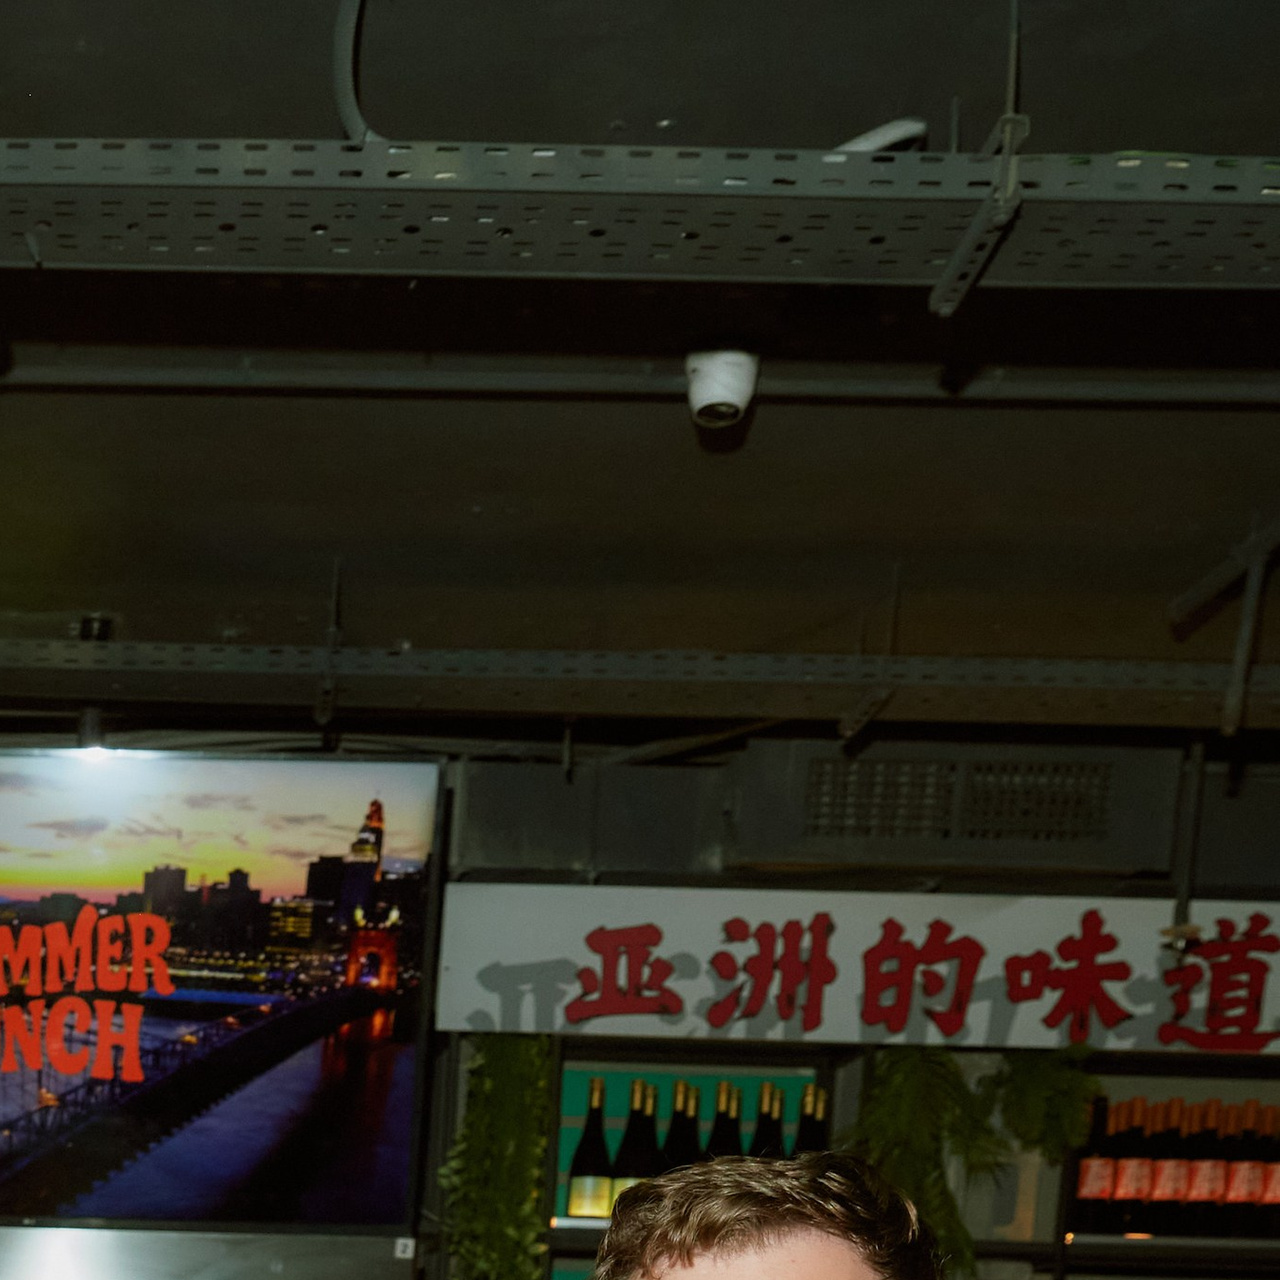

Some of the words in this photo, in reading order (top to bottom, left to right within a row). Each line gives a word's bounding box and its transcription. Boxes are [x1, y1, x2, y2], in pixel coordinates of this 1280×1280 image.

[564, 909, 1280, 1055] 亚洲的味道
